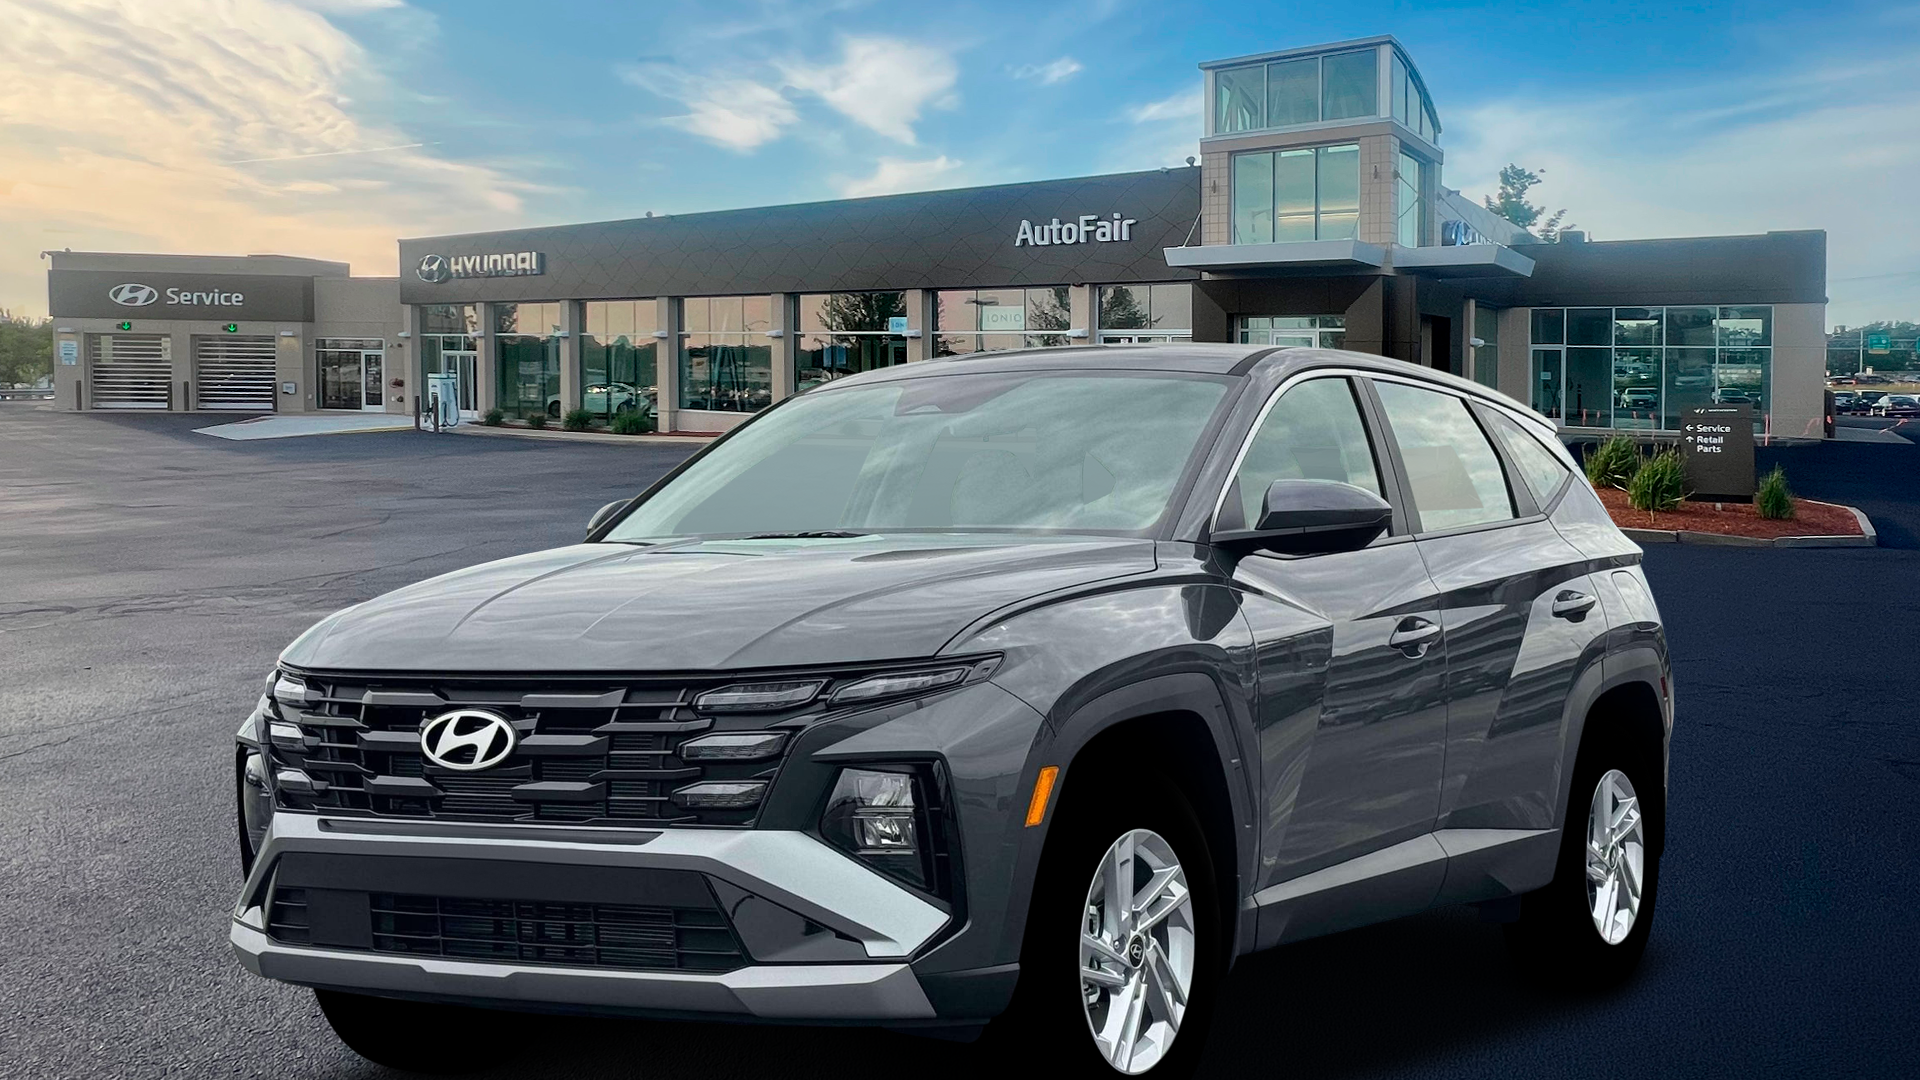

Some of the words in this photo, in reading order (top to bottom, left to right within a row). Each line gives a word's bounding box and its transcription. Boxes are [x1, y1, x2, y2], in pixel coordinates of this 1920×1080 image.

[1015, 213, 1137, 247] AutoFair
[450, 251, 540, 277] HYUNDAI
[166, 287, 244, 306] Service
[1696, 424, 1731, 432] Service
[1696, 436, 1724, 444] Retail
[1696, 445, 1722, 453] Parts
